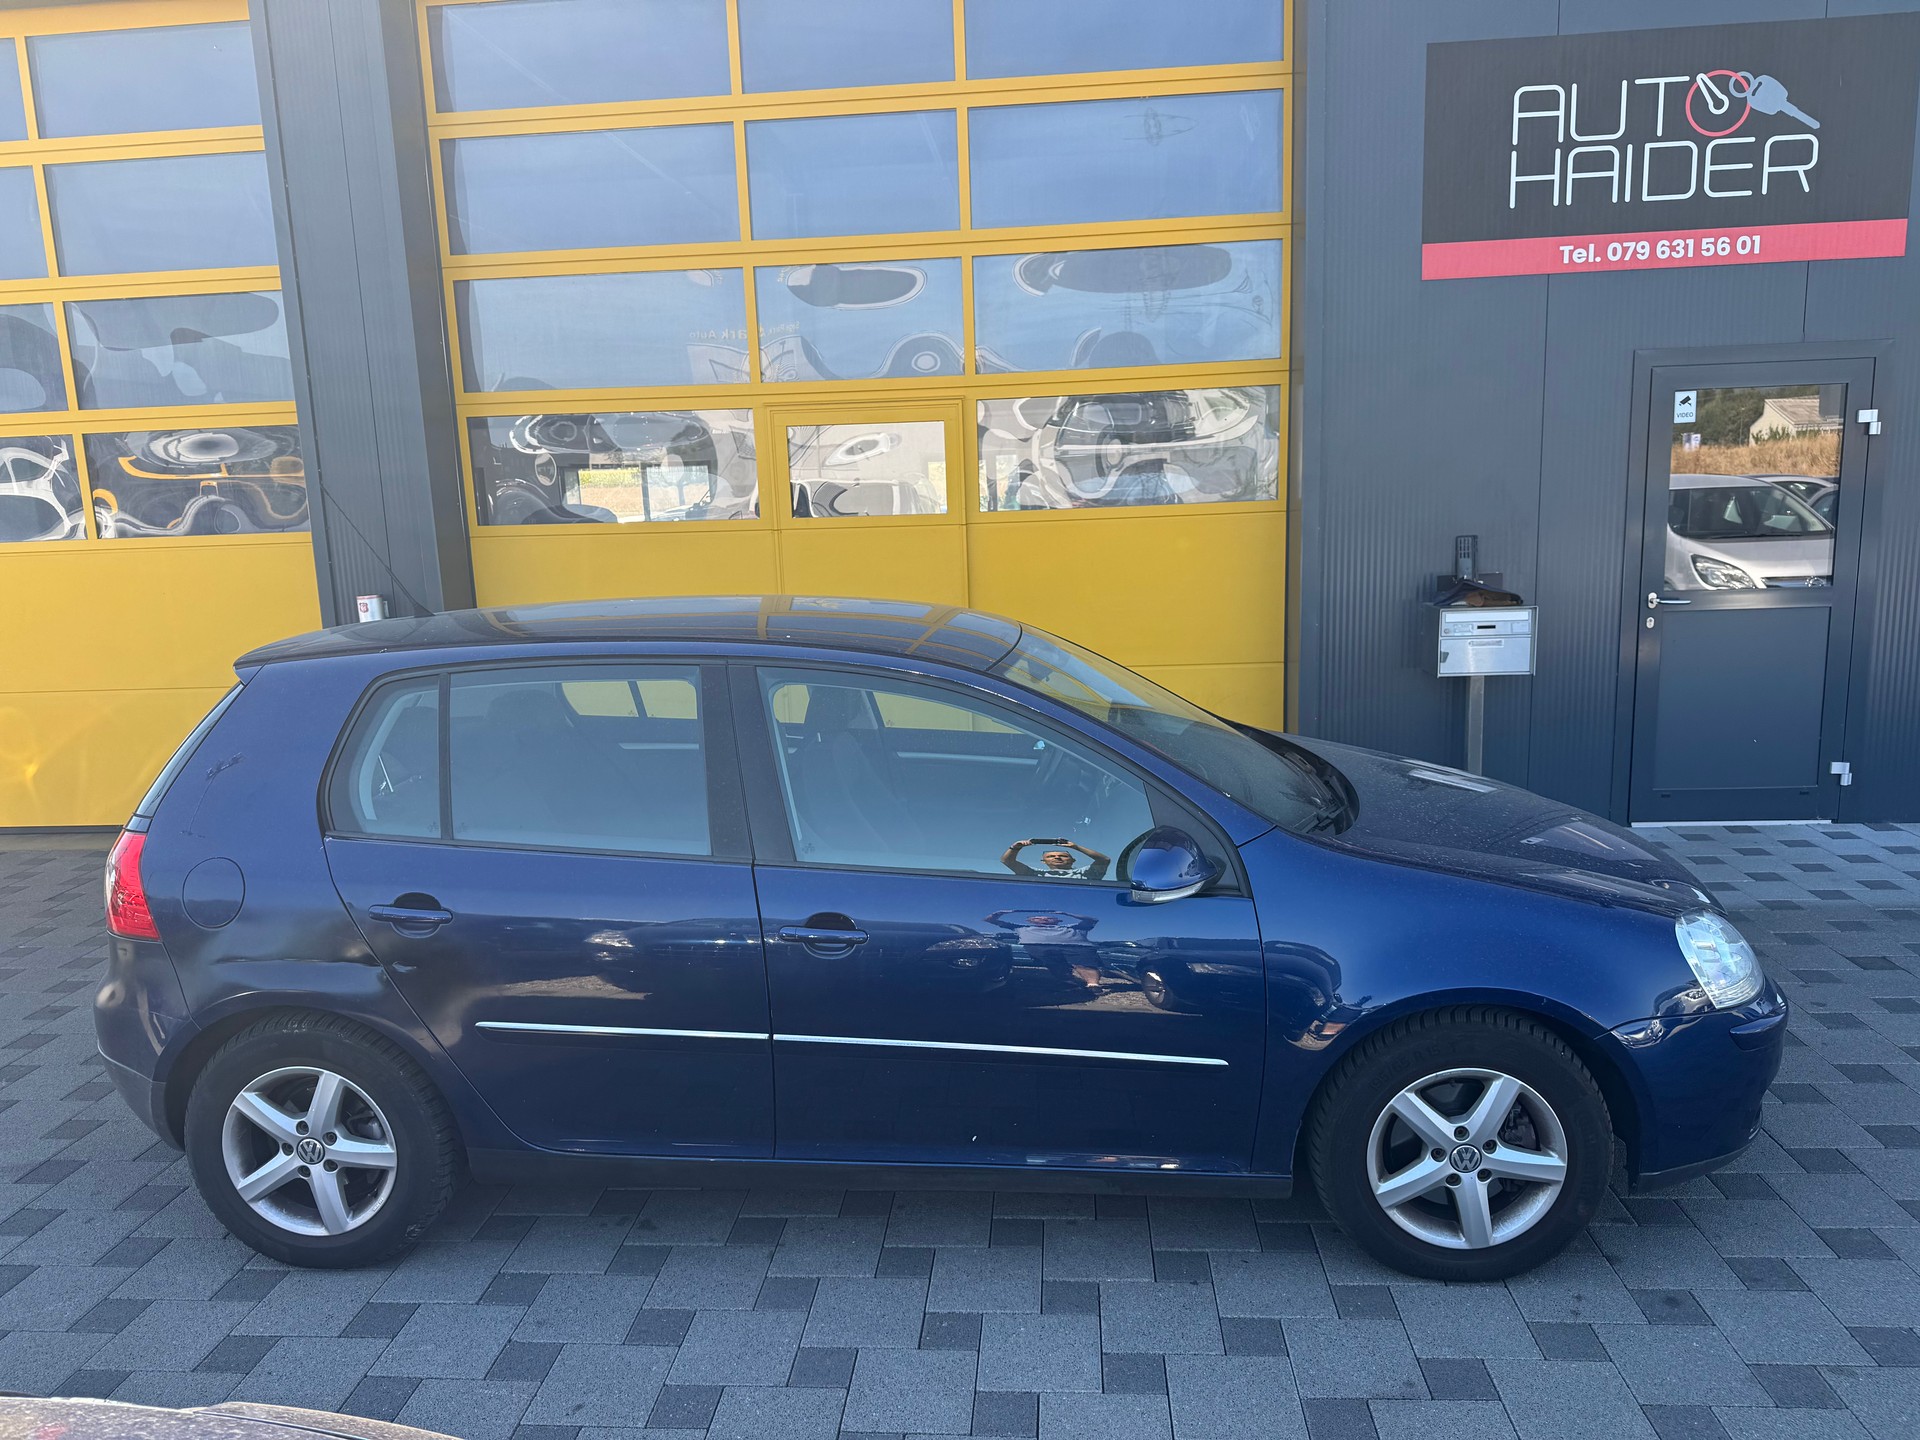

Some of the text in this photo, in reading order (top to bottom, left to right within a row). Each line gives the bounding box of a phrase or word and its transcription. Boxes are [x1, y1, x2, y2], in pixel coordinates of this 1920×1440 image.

[1509, 133, 1819, 209] HAIDER
[1559, 234, 1761, 264] Tel. 079 631 56 01
[1676, 411, 1694, 419] VIDEO
